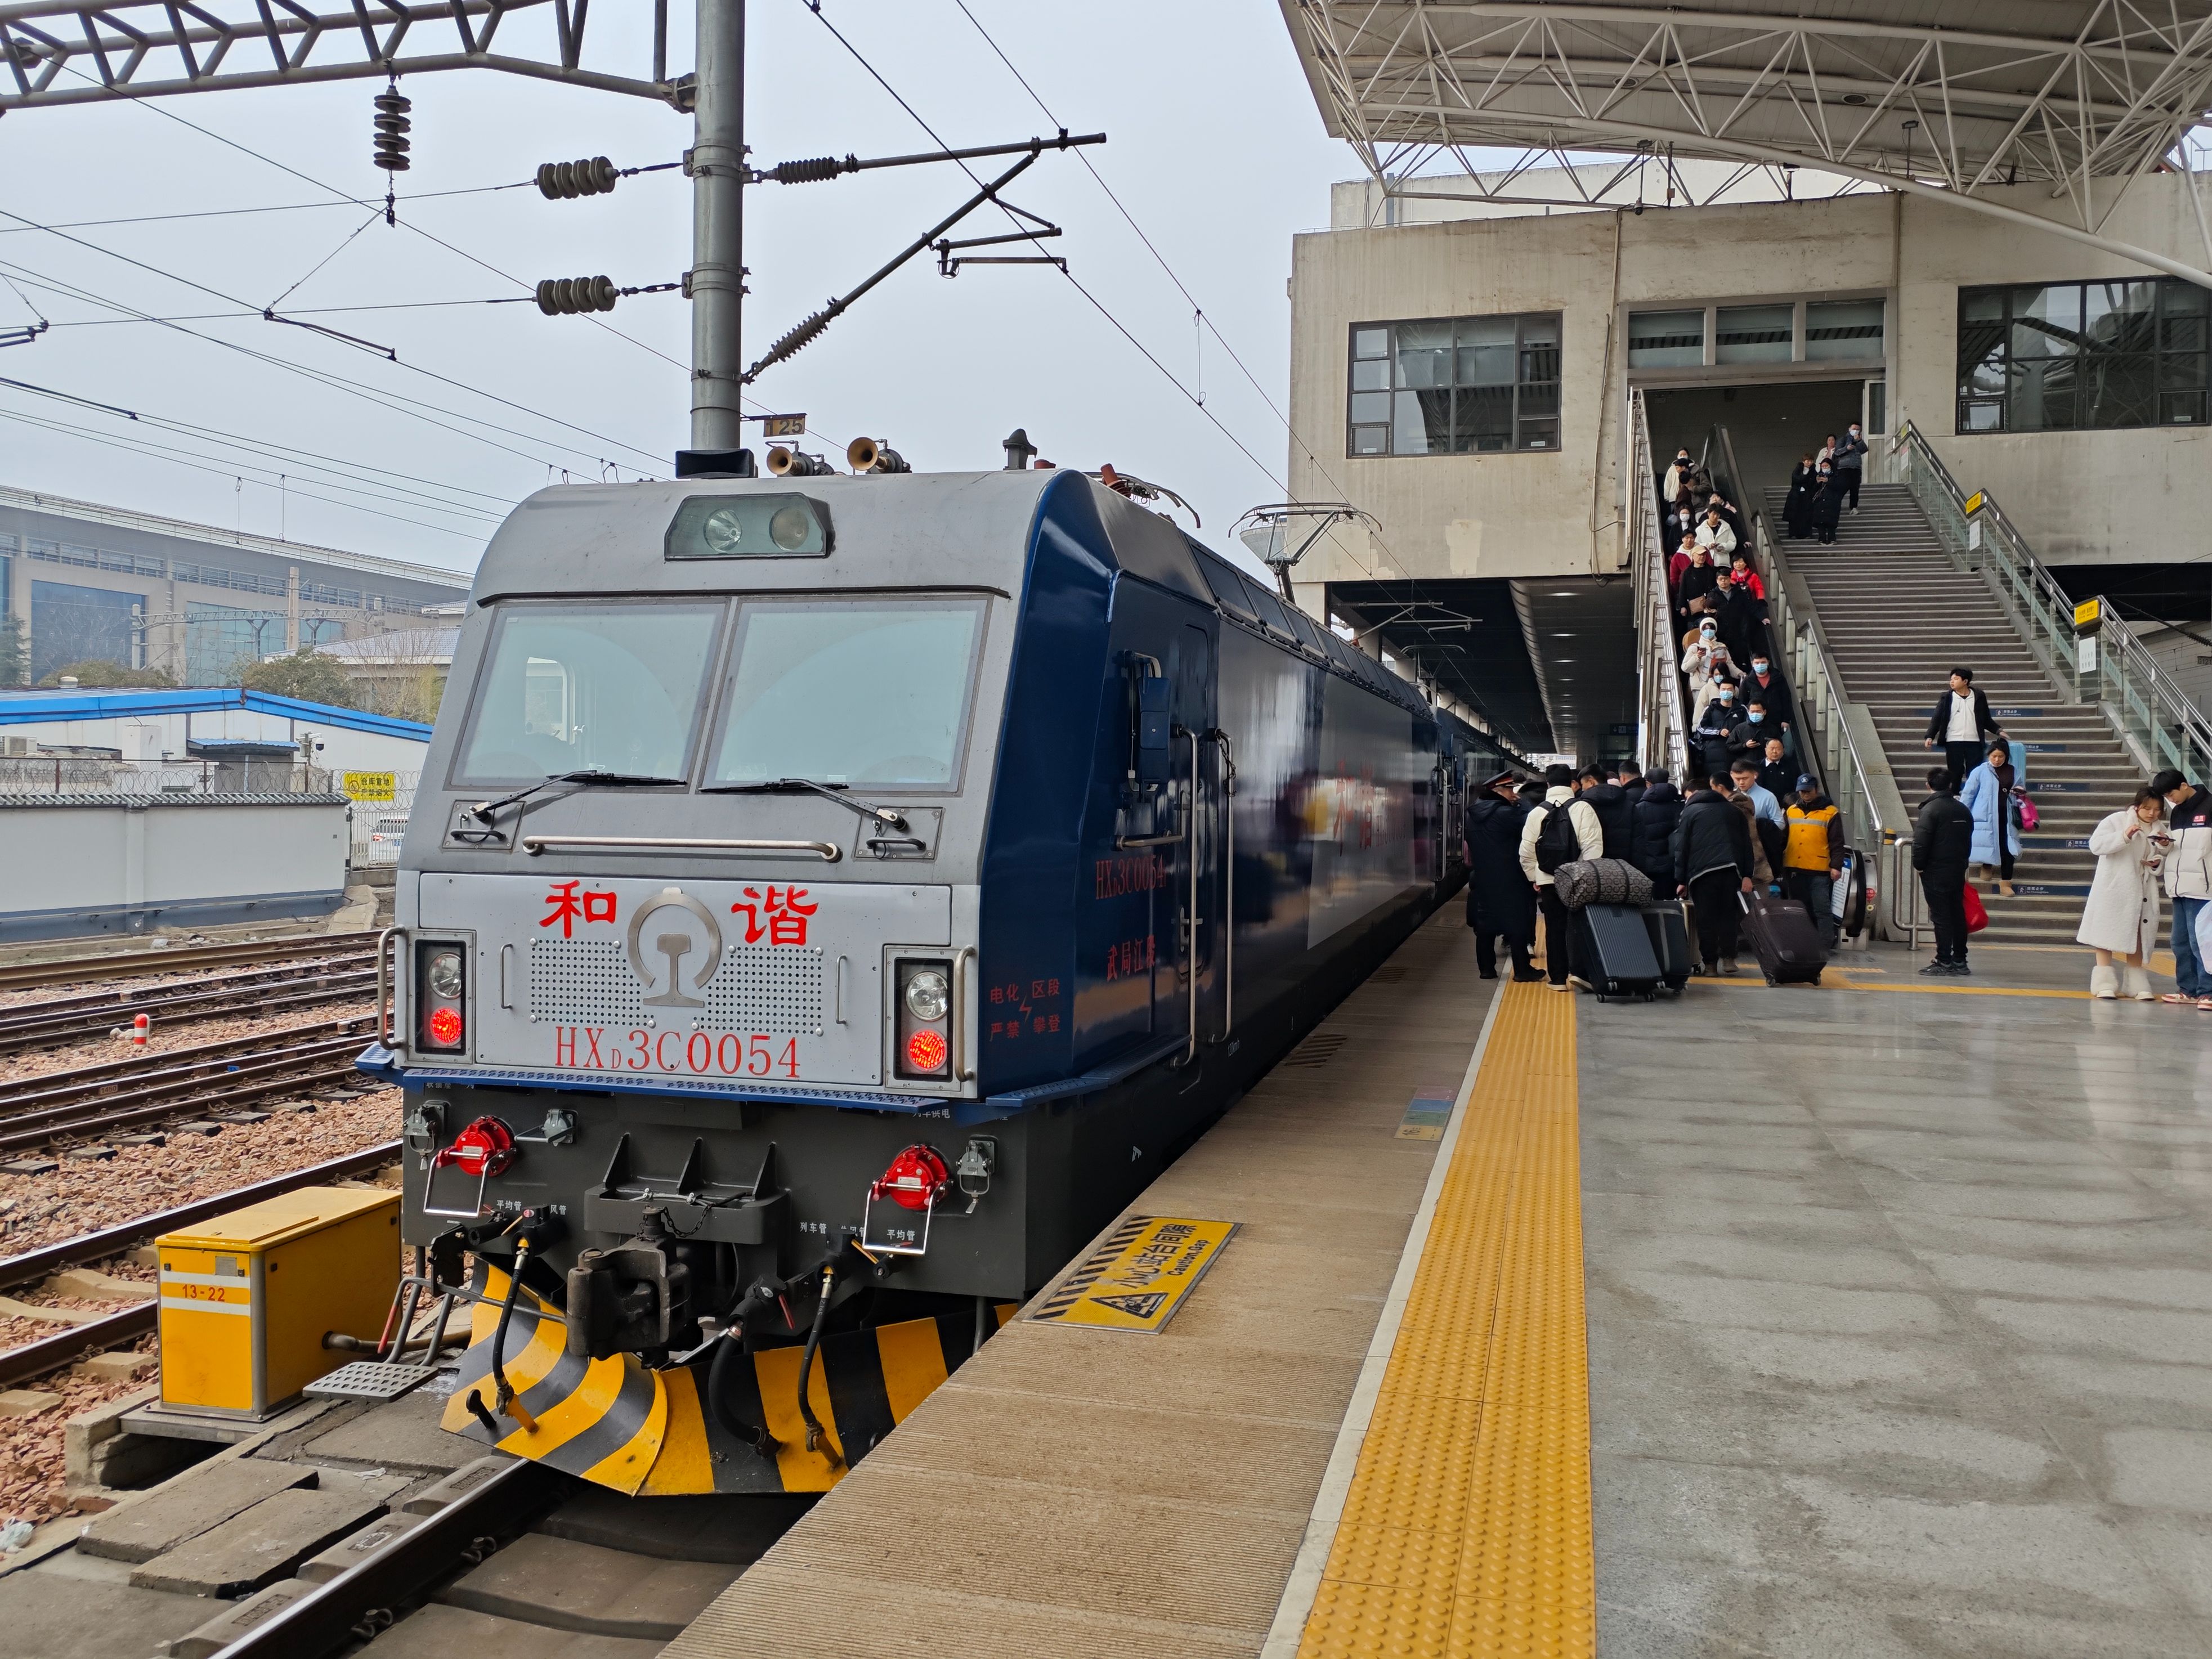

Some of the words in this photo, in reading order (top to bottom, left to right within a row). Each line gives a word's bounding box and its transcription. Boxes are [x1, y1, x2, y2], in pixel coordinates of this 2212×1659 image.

[765, 419, 803, 436] 125
[555, 1026, 801, 1079] HXD3C0054
[496, 1200, 522, 1211] 平均管
[799, 1222, 827, 1235] 列车管
[886, 1229, 916, 1241] 平均管
[1113, 1223, 1198, 1290] 小心站台间隙
[182, 1283, 226, 1303] 13-22
